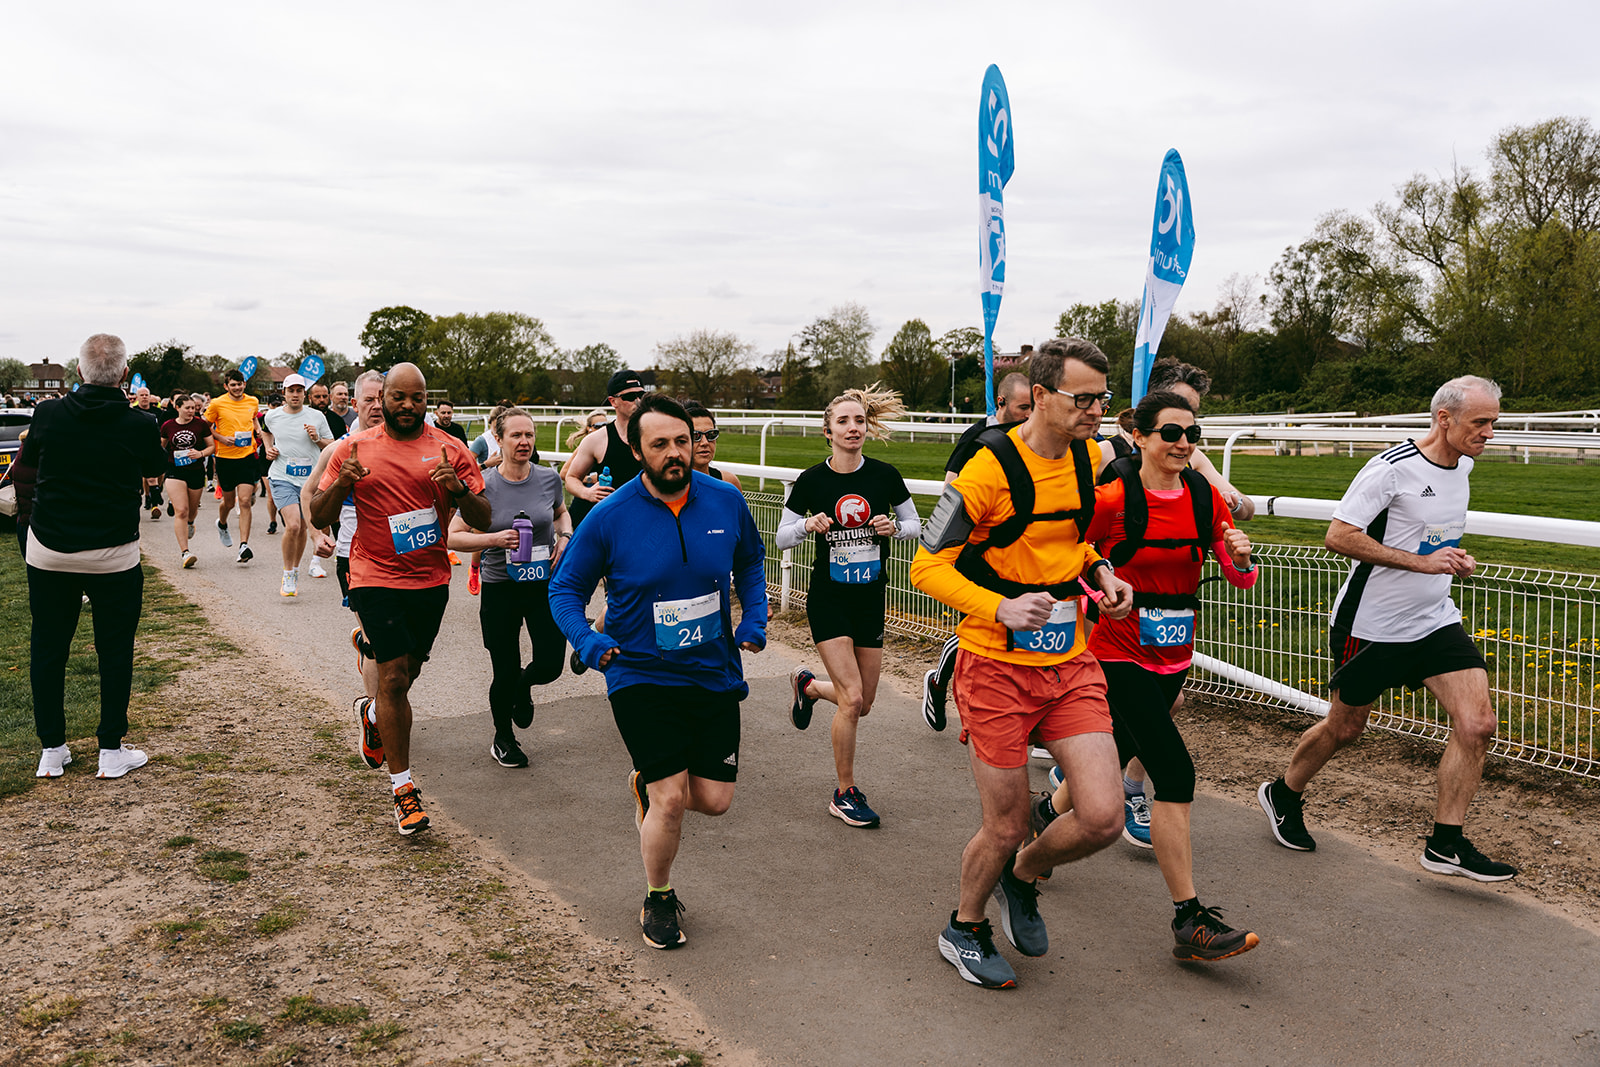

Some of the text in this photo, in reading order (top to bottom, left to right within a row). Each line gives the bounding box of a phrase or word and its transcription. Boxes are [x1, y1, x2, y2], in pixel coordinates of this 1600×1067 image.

[305, 358, 321, 375] 55
[179, 457, 192, 465] 113
[292, 468, 307, 476] 119
[393, 522, 411, 534] 10k
[825, 527, 877, 542] CENTURIO
[407, 529, 437, 549] 195
[835, 537, 873, 548] FITNESS
[1426, 534, 1442, 543] 10k
[833, 555, 849, 564] 10k
[517, 565, 545, 581] 280
[843, 567, 872, 582] 114
[658, 613, 679, 623] 10k
[1144, 608, 1164, 618] 10k
[678, 625, 704, 647] 24
[1029, 629, 1066, 651] 330
[1156, 624, 1187, 644] 329
